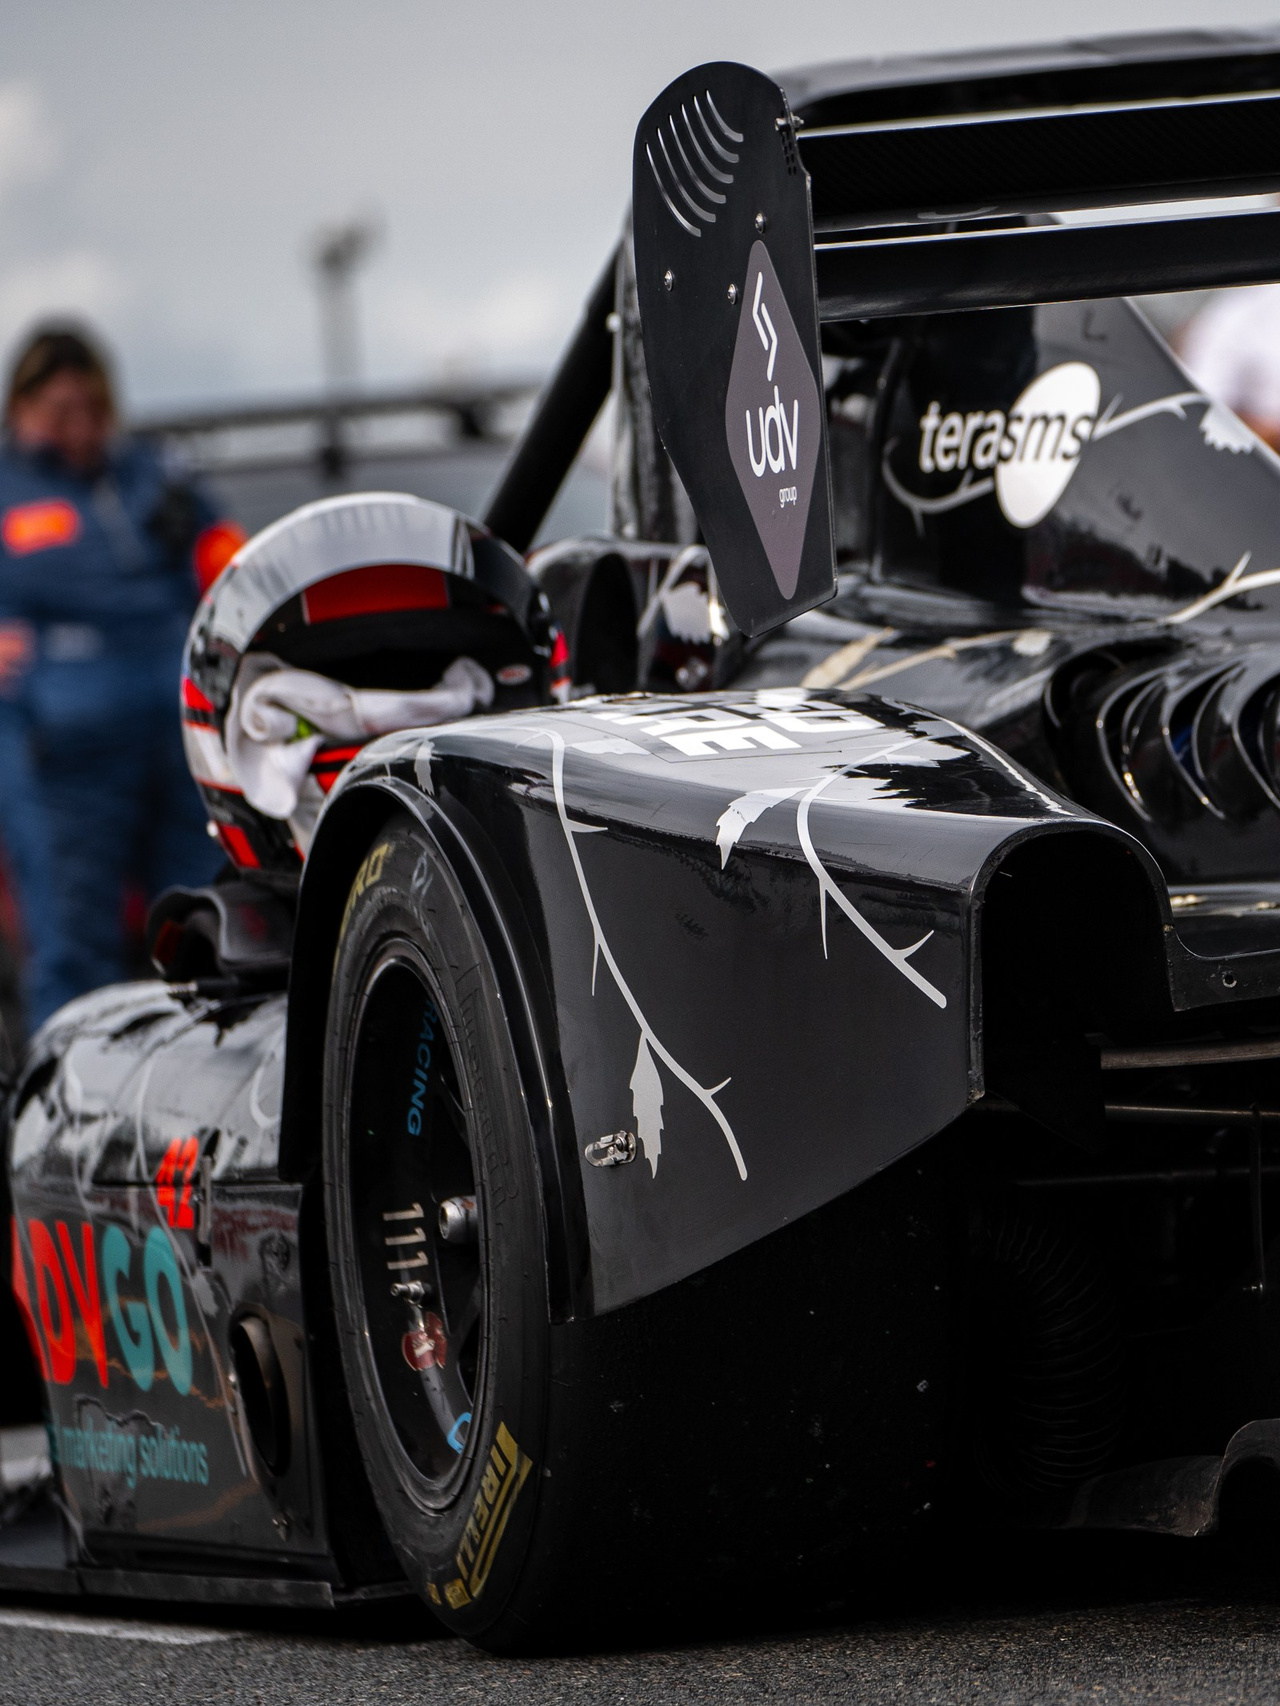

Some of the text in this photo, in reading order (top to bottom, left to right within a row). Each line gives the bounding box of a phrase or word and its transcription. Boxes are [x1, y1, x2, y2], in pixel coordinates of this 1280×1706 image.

[745, 385, 799, 477] udv
[918, 400, 1096, 474] terasms
[778, 485, 798, 508] group
[407, 995, 440, 1136] RACING
[139, 1423, 209, 1486] solutions
[455, 1421, 534, 1598] PIRELLI
